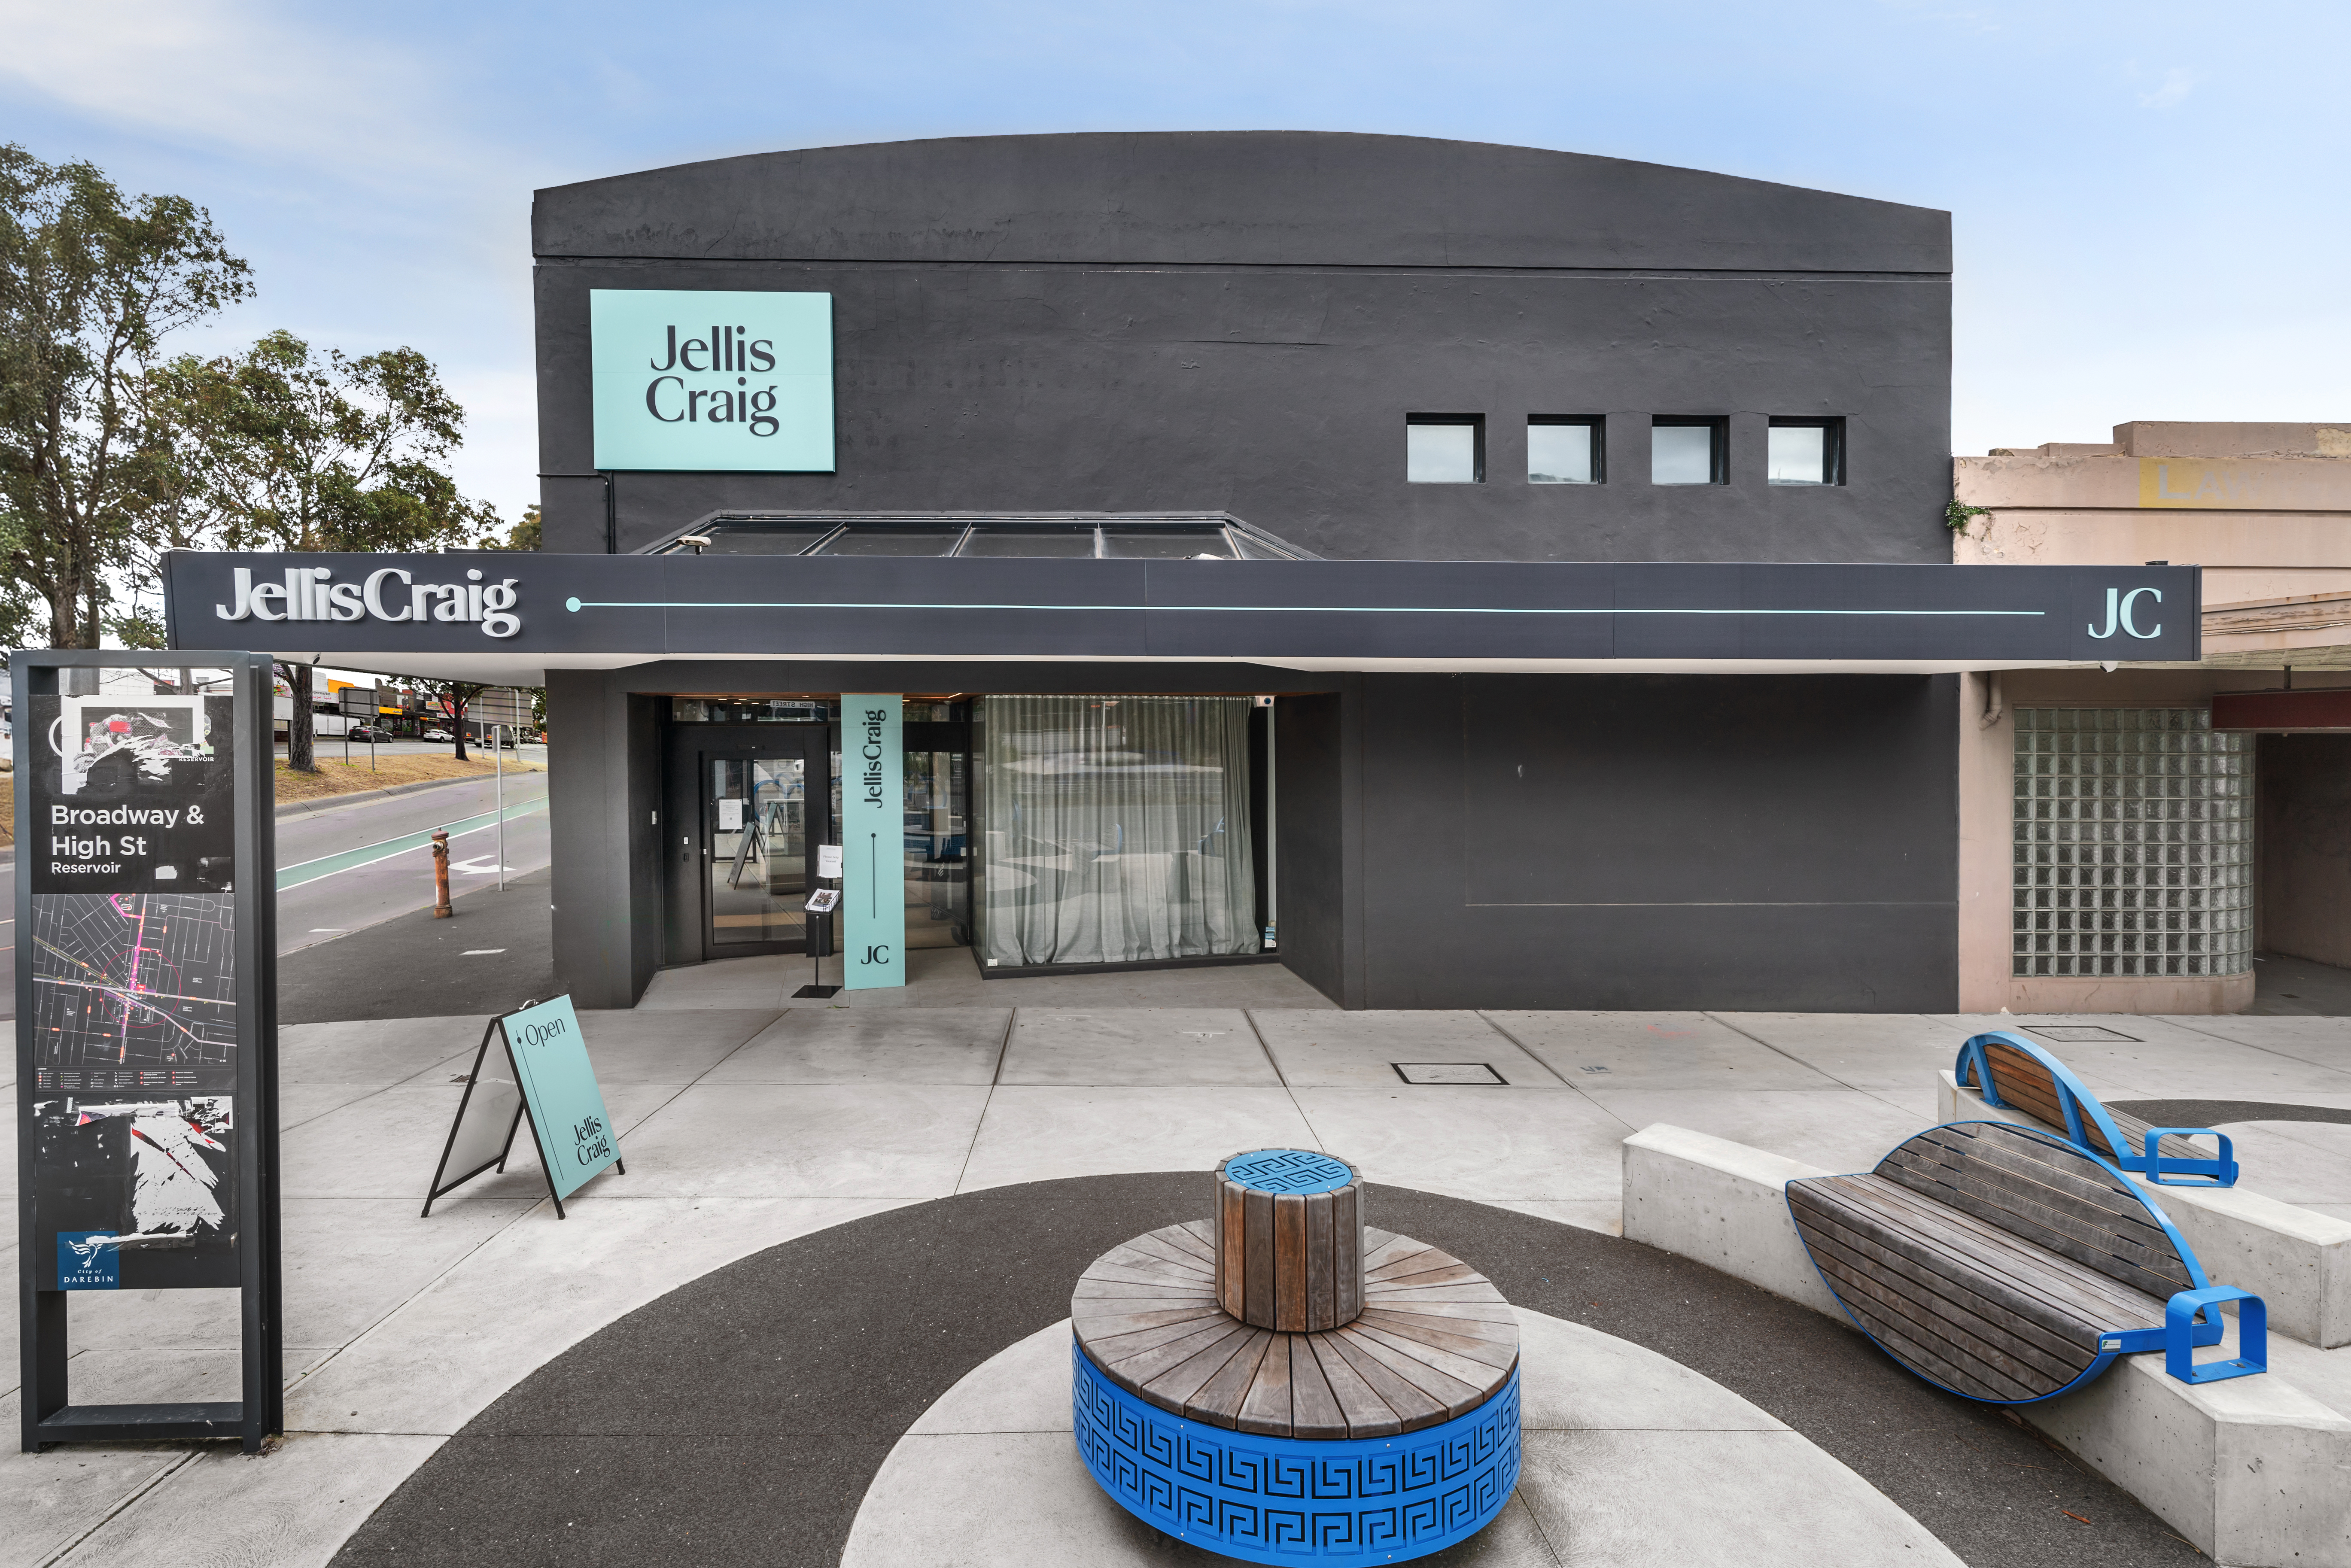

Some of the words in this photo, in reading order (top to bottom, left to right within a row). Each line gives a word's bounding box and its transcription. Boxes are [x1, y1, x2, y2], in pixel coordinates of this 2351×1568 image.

[651, 325, 776, 372] Jellis
[646, 376, 780, 437] Craig
[216, 567, 521, 638] JellisCraig
[2088, 587, 2162, 639] JC
[862, 710, 886, 808] JellisCraig
[52, 805, 179, 829] Broadway
[186, 805, 204, 825] &
[52, 836, 111, 860] High
[120, 836, 147, 856] St
[52, 861, 121, 873] Reservoir
[861, 945, 888, 964] JC
[525, 1018, 566, 1046] Open
[574, 1115, 602, 1146] Jellis
[577, 1136, 611, 1166] Craig
